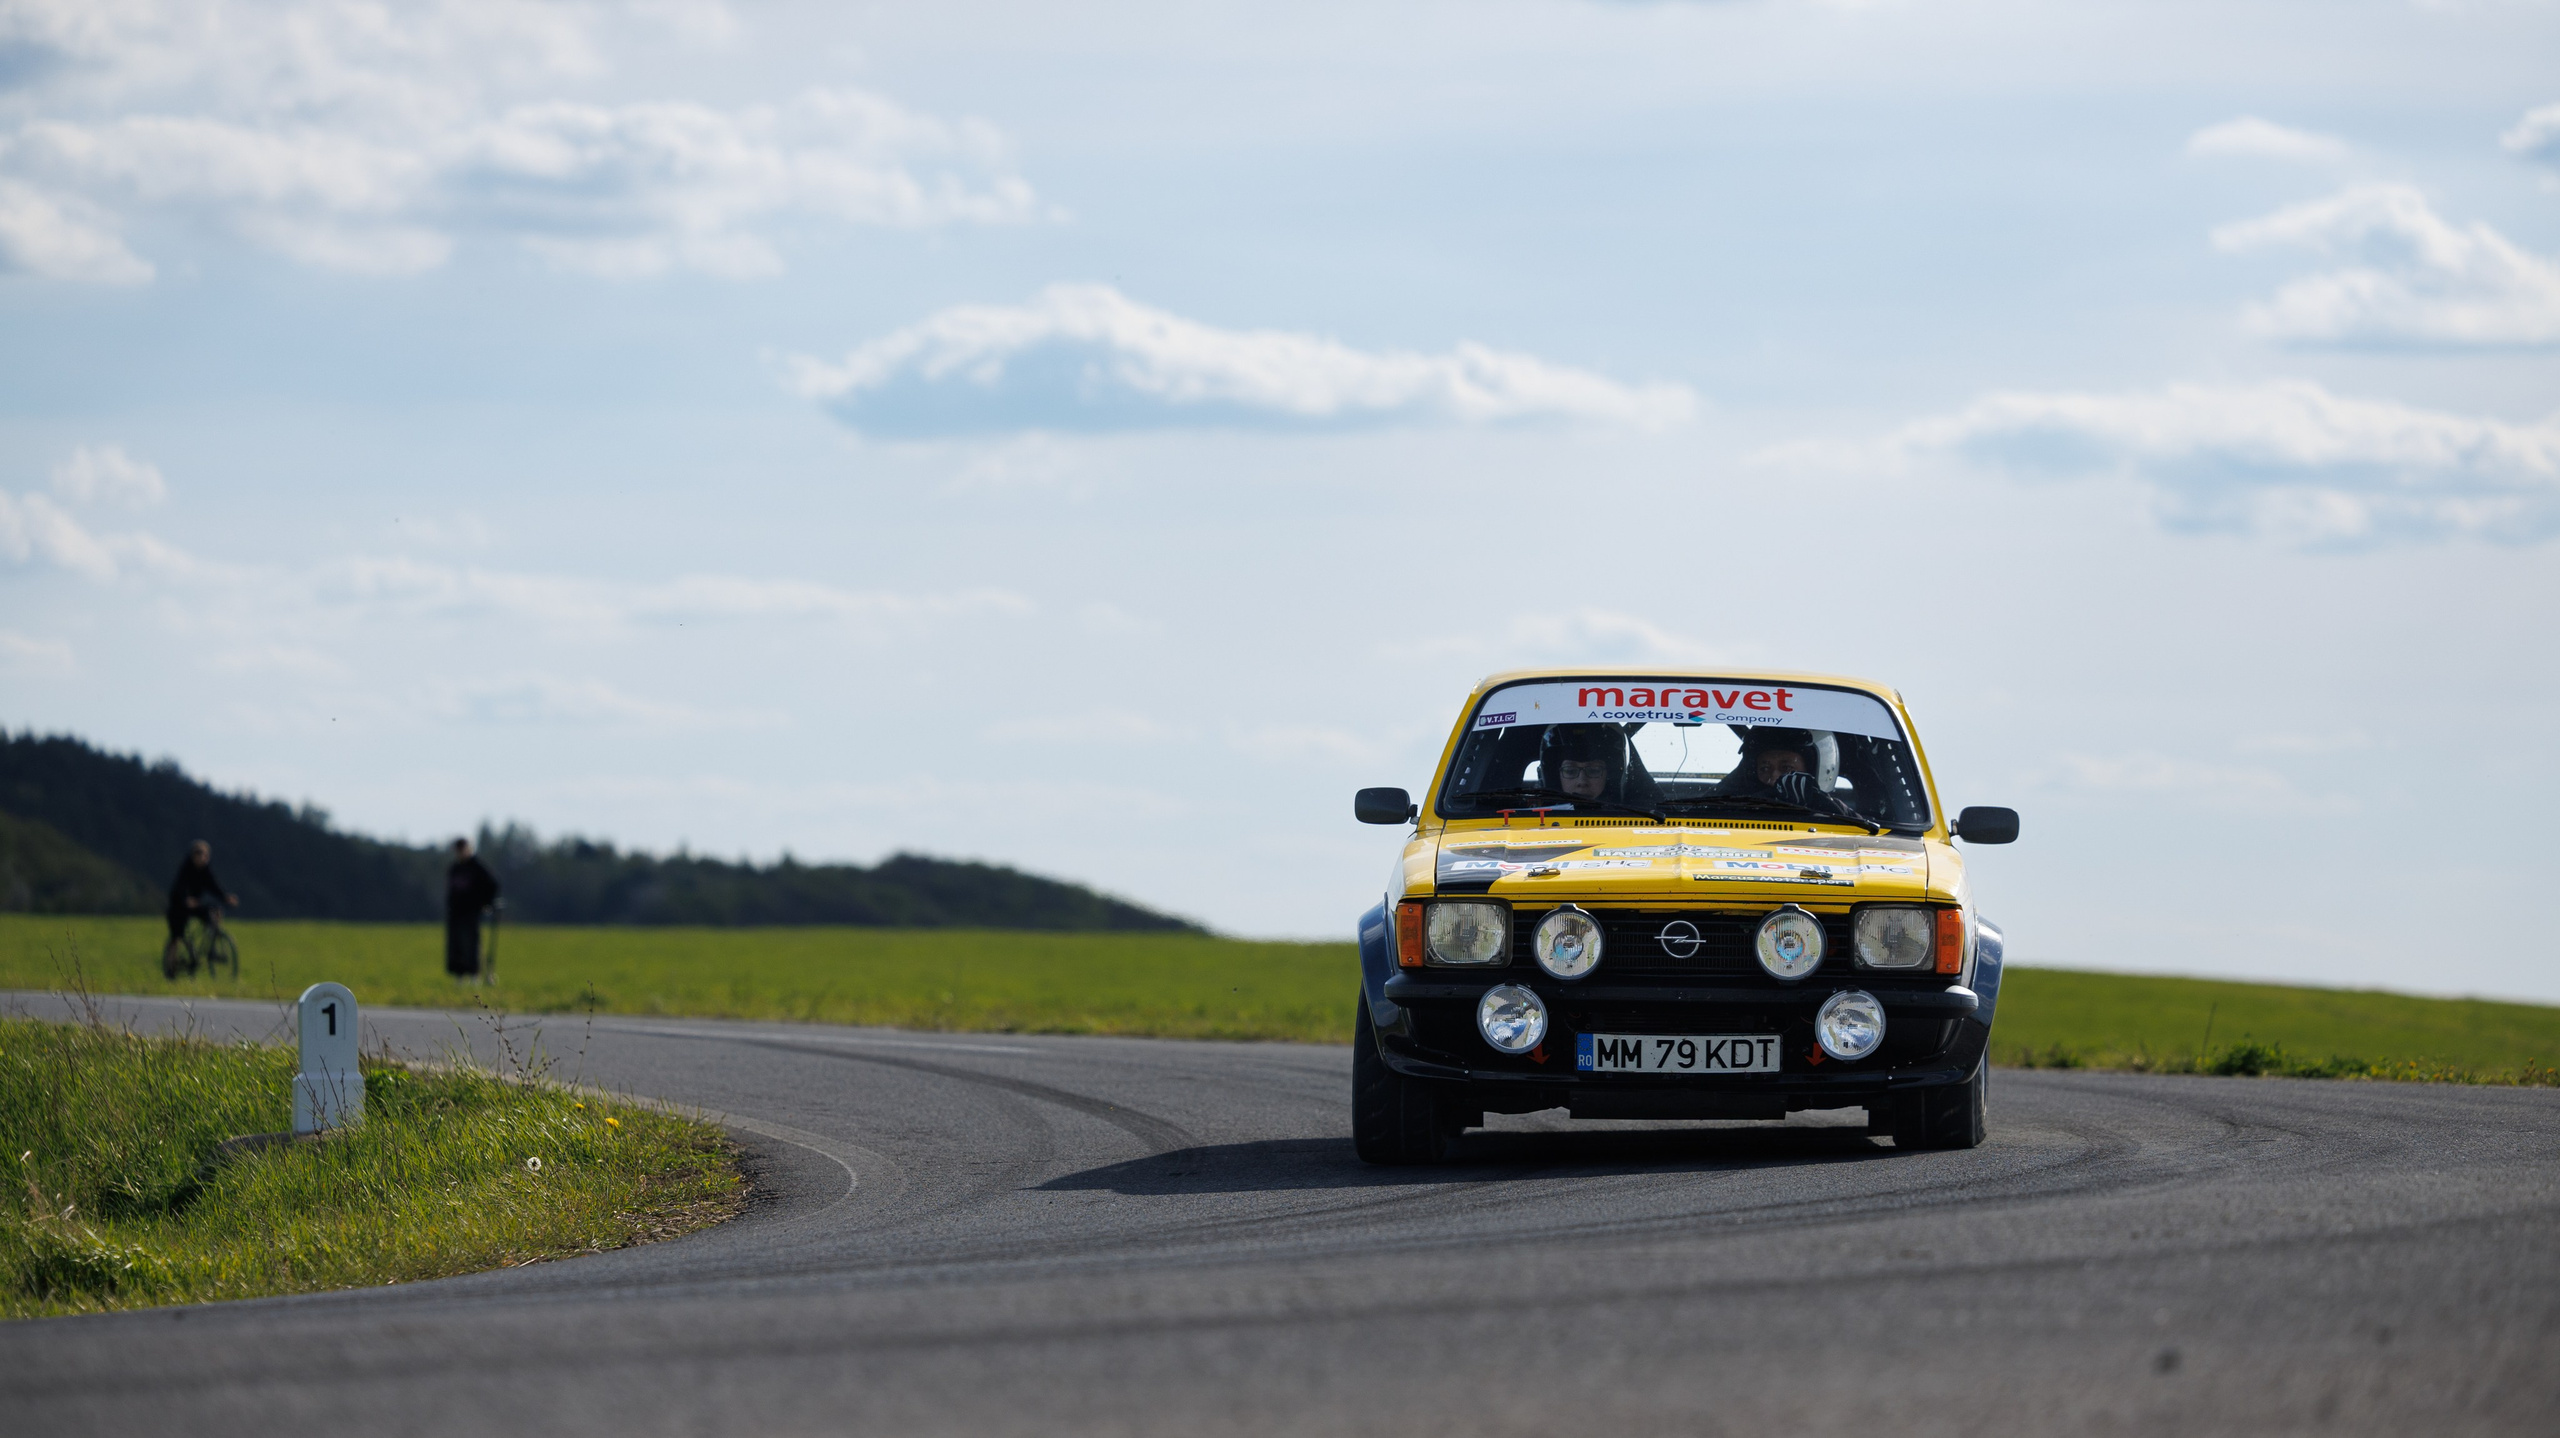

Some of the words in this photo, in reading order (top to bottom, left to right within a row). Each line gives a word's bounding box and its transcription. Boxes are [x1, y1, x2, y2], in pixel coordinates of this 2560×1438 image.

[1578, 687, 1794, 712] maravet
[1588, 711, 1598, 719] A
[1603, 710, 1684, 720] covetrus
[1715, 712, 1783, 725] Company
[1583, 860, 1646, 868] SHC
[1726, 861, 1831, 873] Mobil
[1846, 864, 1909, 874] SHC
[1759, 876, 1853, 886] Motorsport
[322, 1003, 336, 1036] 1
[1597, 1038, 1642, 1068] MM
[1656, 1039, 1696, 1068] 79
[1705, 1039, 1775, 1068] KDT
[1578, 1054, 1592, 1067] RO
